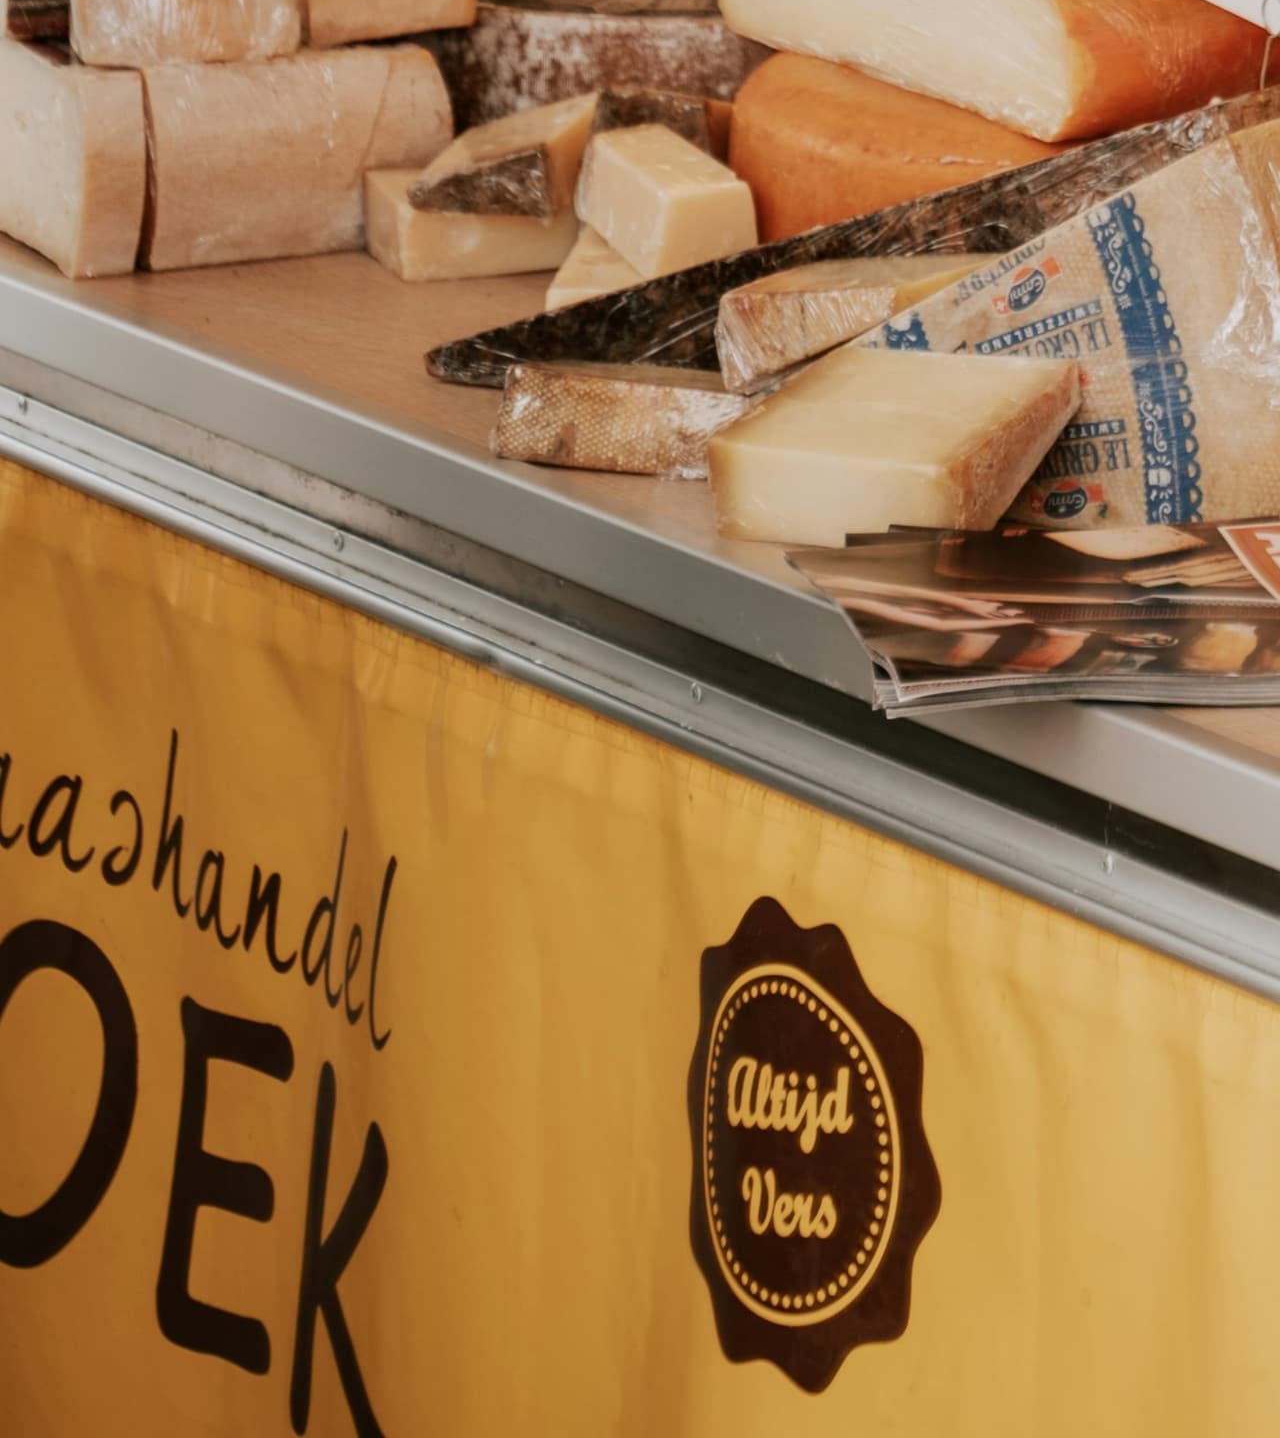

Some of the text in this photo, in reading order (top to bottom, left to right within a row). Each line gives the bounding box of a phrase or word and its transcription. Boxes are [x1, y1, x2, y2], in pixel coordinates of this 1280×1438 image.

[977, 301, 1103, 354] SWITZERLAND
[1101, 437, 1131, 470] LE
[725, 1055, 854, 1156] Altijd
[0, 919, 387, 1438] OEK
[739, 1166, 839, 1243] Vers
